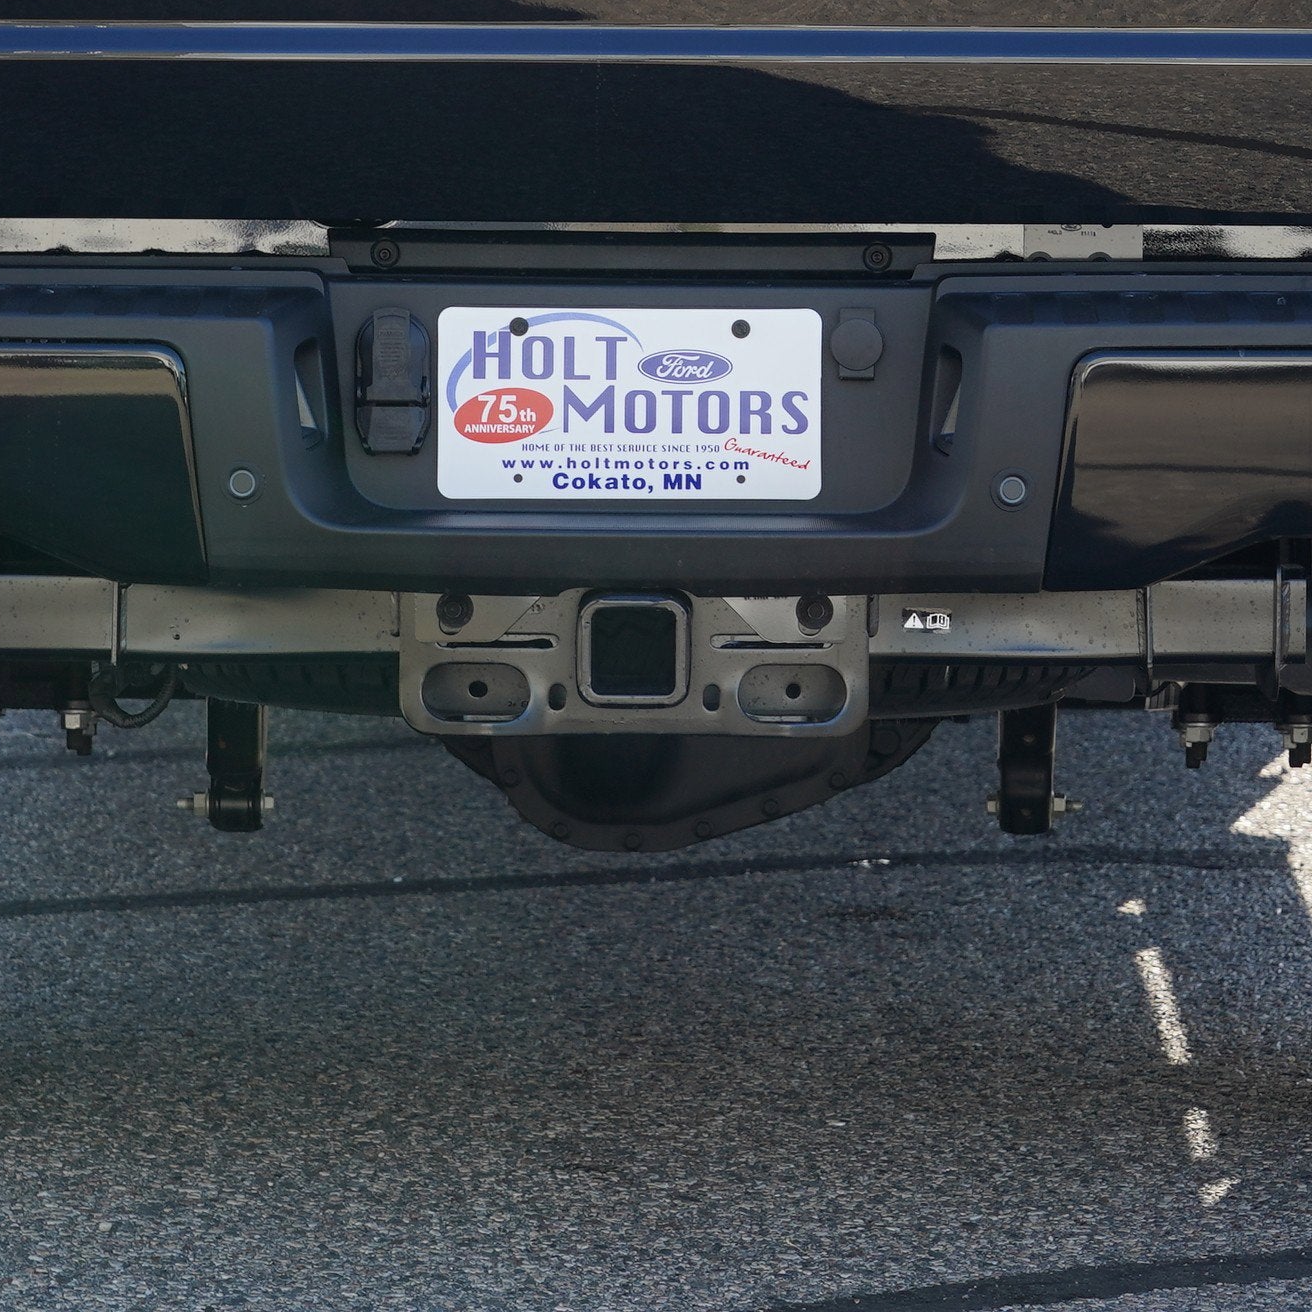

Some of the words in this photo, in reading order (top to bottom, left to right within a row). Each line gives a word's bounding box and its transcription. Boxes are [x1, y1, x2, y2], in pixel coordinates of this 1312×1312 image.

[472, 329, 628, 381] HOLT
[656, 353, 715, 379] Ford
[476, 394, 537, 424] 75th
[562, 384, 809, 436] MOTORS
[464, 423, 536, 435] ANNIVERSARY
[521, 443, 550, 452] HOME
[554, 443, 566, 452] OF
[570, 443, 587, 452] THE
[590, 444, 613, 453] BEST
[617, 444, 658, 453] SERVICE
[662, 444, 691, 453] SINCE
[695, 444, 720, 453] 1950
[724, 437, 811, 470] Guaranteed
[501, 457, 750, 472] www.holtmotors.com
[552, 472, 655, 494] Cokato,
[662, 473, 703, 490] MN
